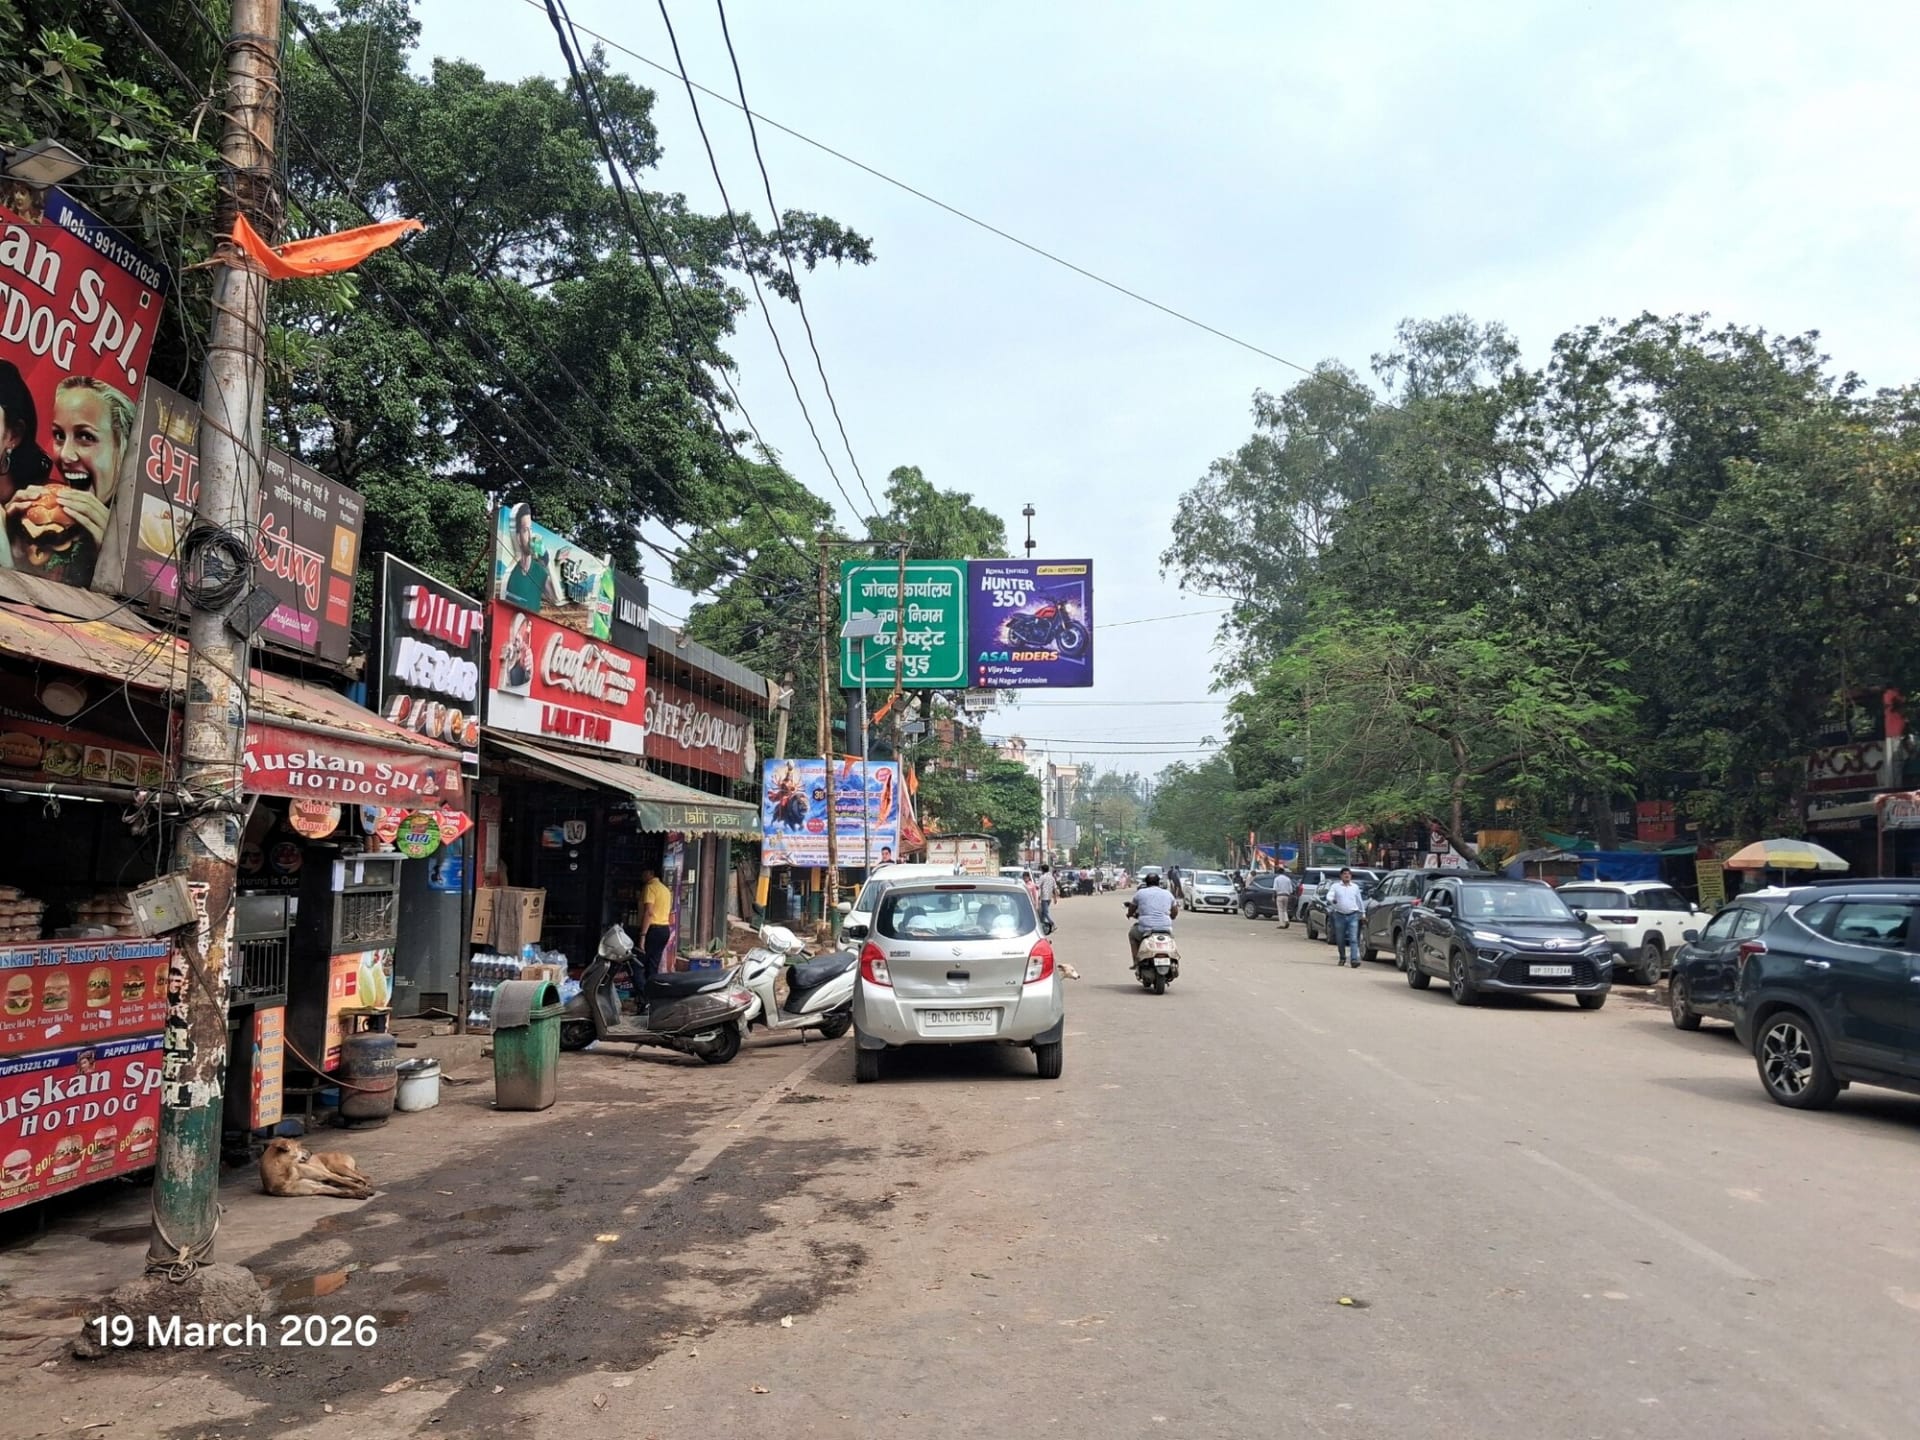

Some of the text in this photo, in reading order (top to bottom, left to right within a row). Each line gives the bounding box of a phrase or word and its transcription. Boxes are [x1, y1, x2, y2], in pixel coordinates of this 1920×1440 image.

[94, 231, 161, 290] 9911371626
[0, 218, 143, 384] an Spl.
[981, 576, 1035, 591] HUNTER
[619, 596, 637, 627] LALIT
[992, 591, 1026, 608] 350
[410, 585, 473, 649] DILLI
[908, 603, 944, 623] निगम
[394, 637, 478, 702] KEBAB
[978, 651, 1059, 662] ASA RIDERS
[987, 666, 1023, 675] Vijay Nagar
[987, 676, 1047, 685] Raj Nagar Extension
[541, 705, 582, 736] LALIT
[288, 771, 388, 797] HOTDOG
[375, 762, 423, 795] Spl.
[37, 946, 62, 965] The
[66, 944, 96, 963] Taste
[110, 941, 167, 960] Ghaziabad
[104, 1043, 149, 1057] PAPPU BHAI
[20, 1093, 138, 1137] HOTDOG
